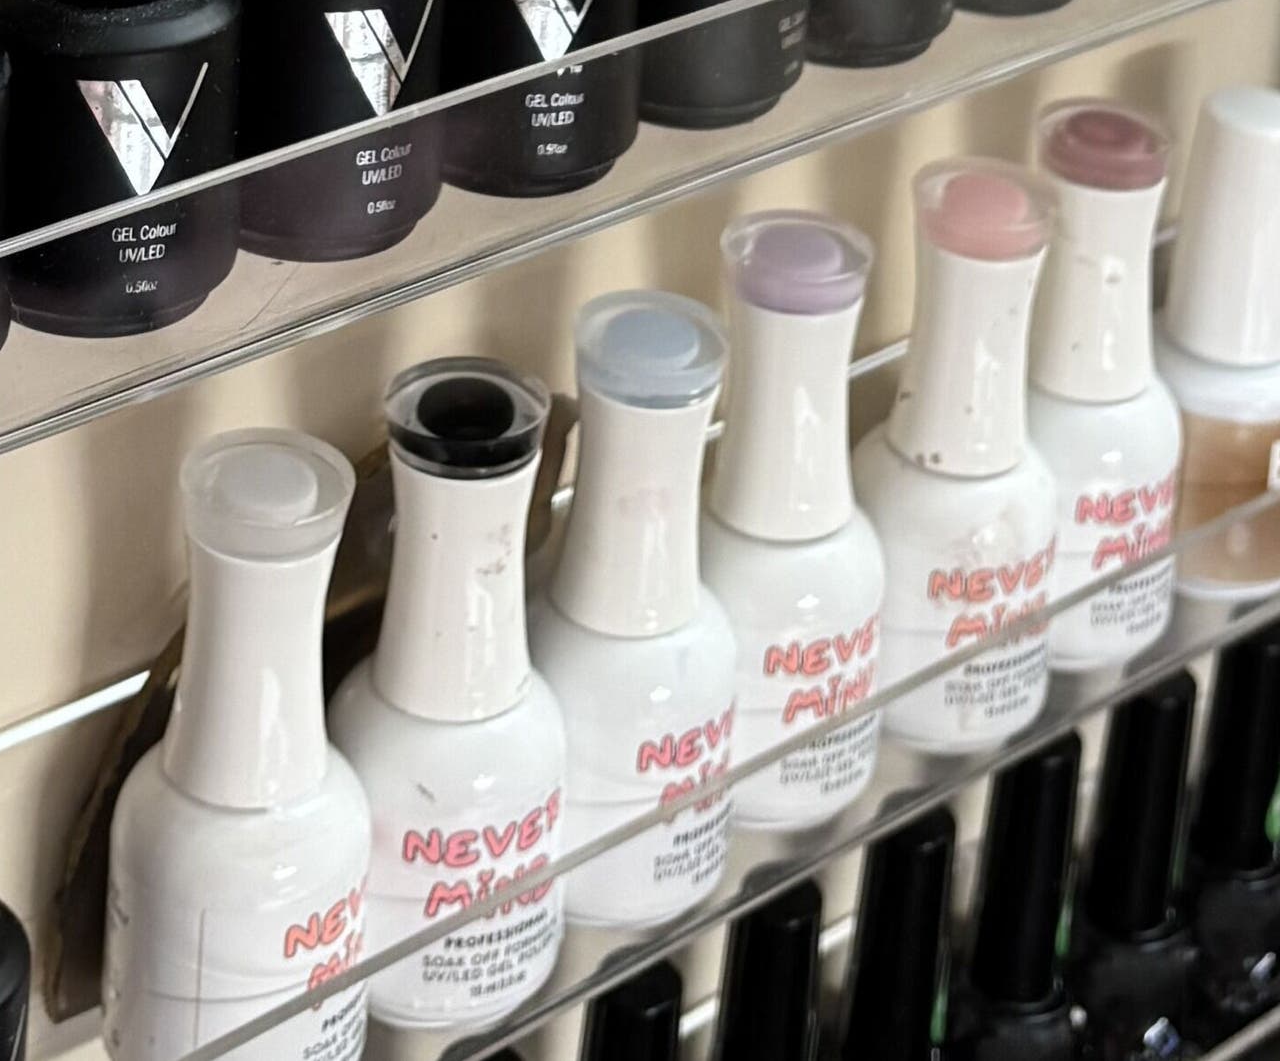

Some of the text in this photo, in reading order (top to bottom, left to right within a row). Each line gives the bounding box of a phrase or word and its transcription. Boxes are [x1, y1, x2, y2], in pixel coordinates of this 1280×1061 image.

[525, 91, 585, 108] GEL Colour
[531, 110, 575, 127] UV/LED
[356, 142, 412, 166] GEL Colour
[361, 164, 402, 186] UV/LED
[112, 222, 177, 243] GEL Colour
[119, 243, 166, 264] UV/LED
